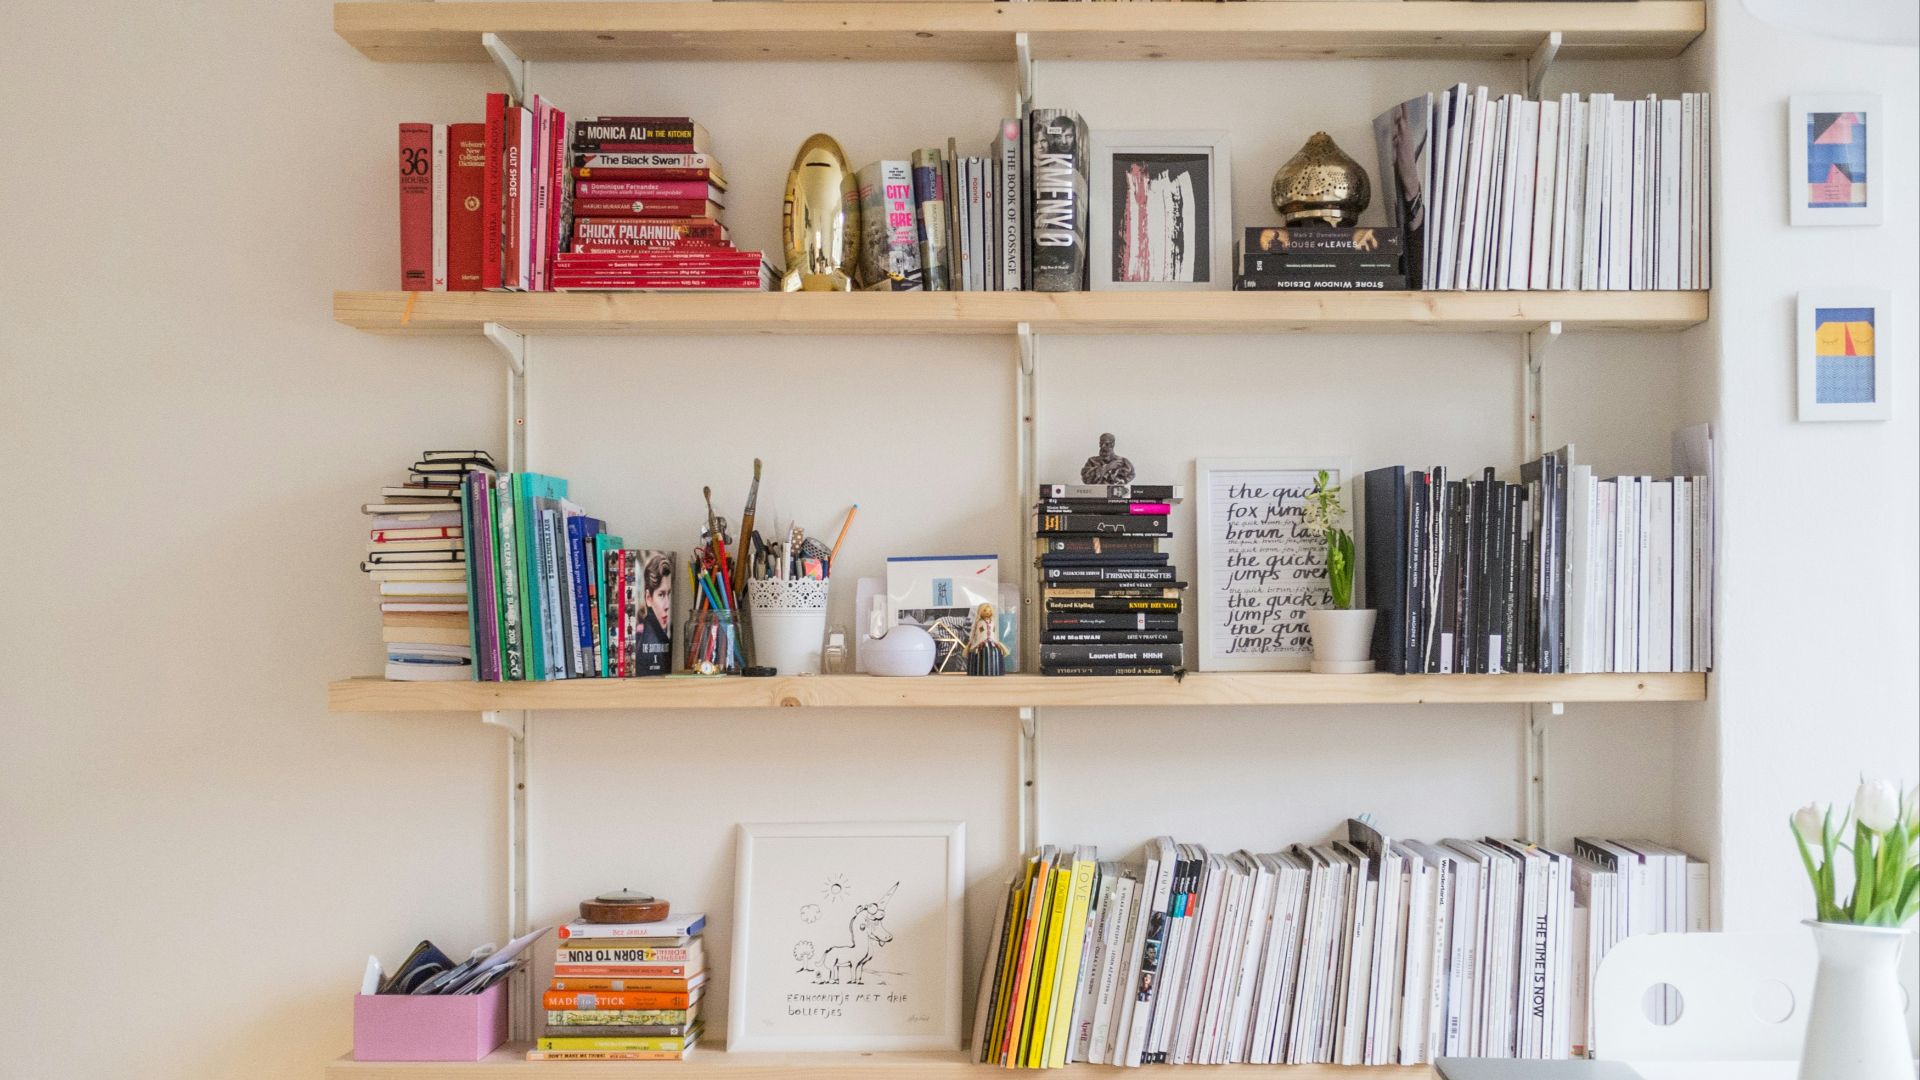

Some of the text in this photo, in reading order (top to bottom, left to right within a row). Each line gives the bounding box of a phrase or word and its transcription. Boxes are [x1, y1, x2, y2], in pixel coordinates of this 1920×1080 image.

[587, 127, 626, 140] MONICA
[630, 127, 646, 140] ALI
[402, 148, 428, 175] 36
[600, 155, 680, 165] The Black Swan
[886, 185, 910, 199] CITY
[1036, 154, 1073, 229] KMENY
[894, 202, 904, 211] ON
[1007, 148, 1016, 275] THE BOOK OF GOSSAGE
[890, 213, 912, 226] FIRE
[579, 225, 618, 238] CHUCK
[619, 225, 681, 240] PALAHNIUK
[1228, 482, 1268, 498] the
[1227, 503, 1257, 521] fox
[1227, 551, 1320, 576] the quick
[1222, 568, 1280, 590] jumps
[1228, 594, 1316, 613] the quick
[1224, 608, 1282, 626] jumps
[1230, 624, 1264, 635] the
[1226, 636, 1284, 654] jumps
[1076, 864, 1090, 901] LOVE
[568, 950, 644, 962] BORN TO RUN
[1533, 914, 1547, 1018] THE TIME IS NOW
[1080, 1020, 1090, 1041] Apetit
